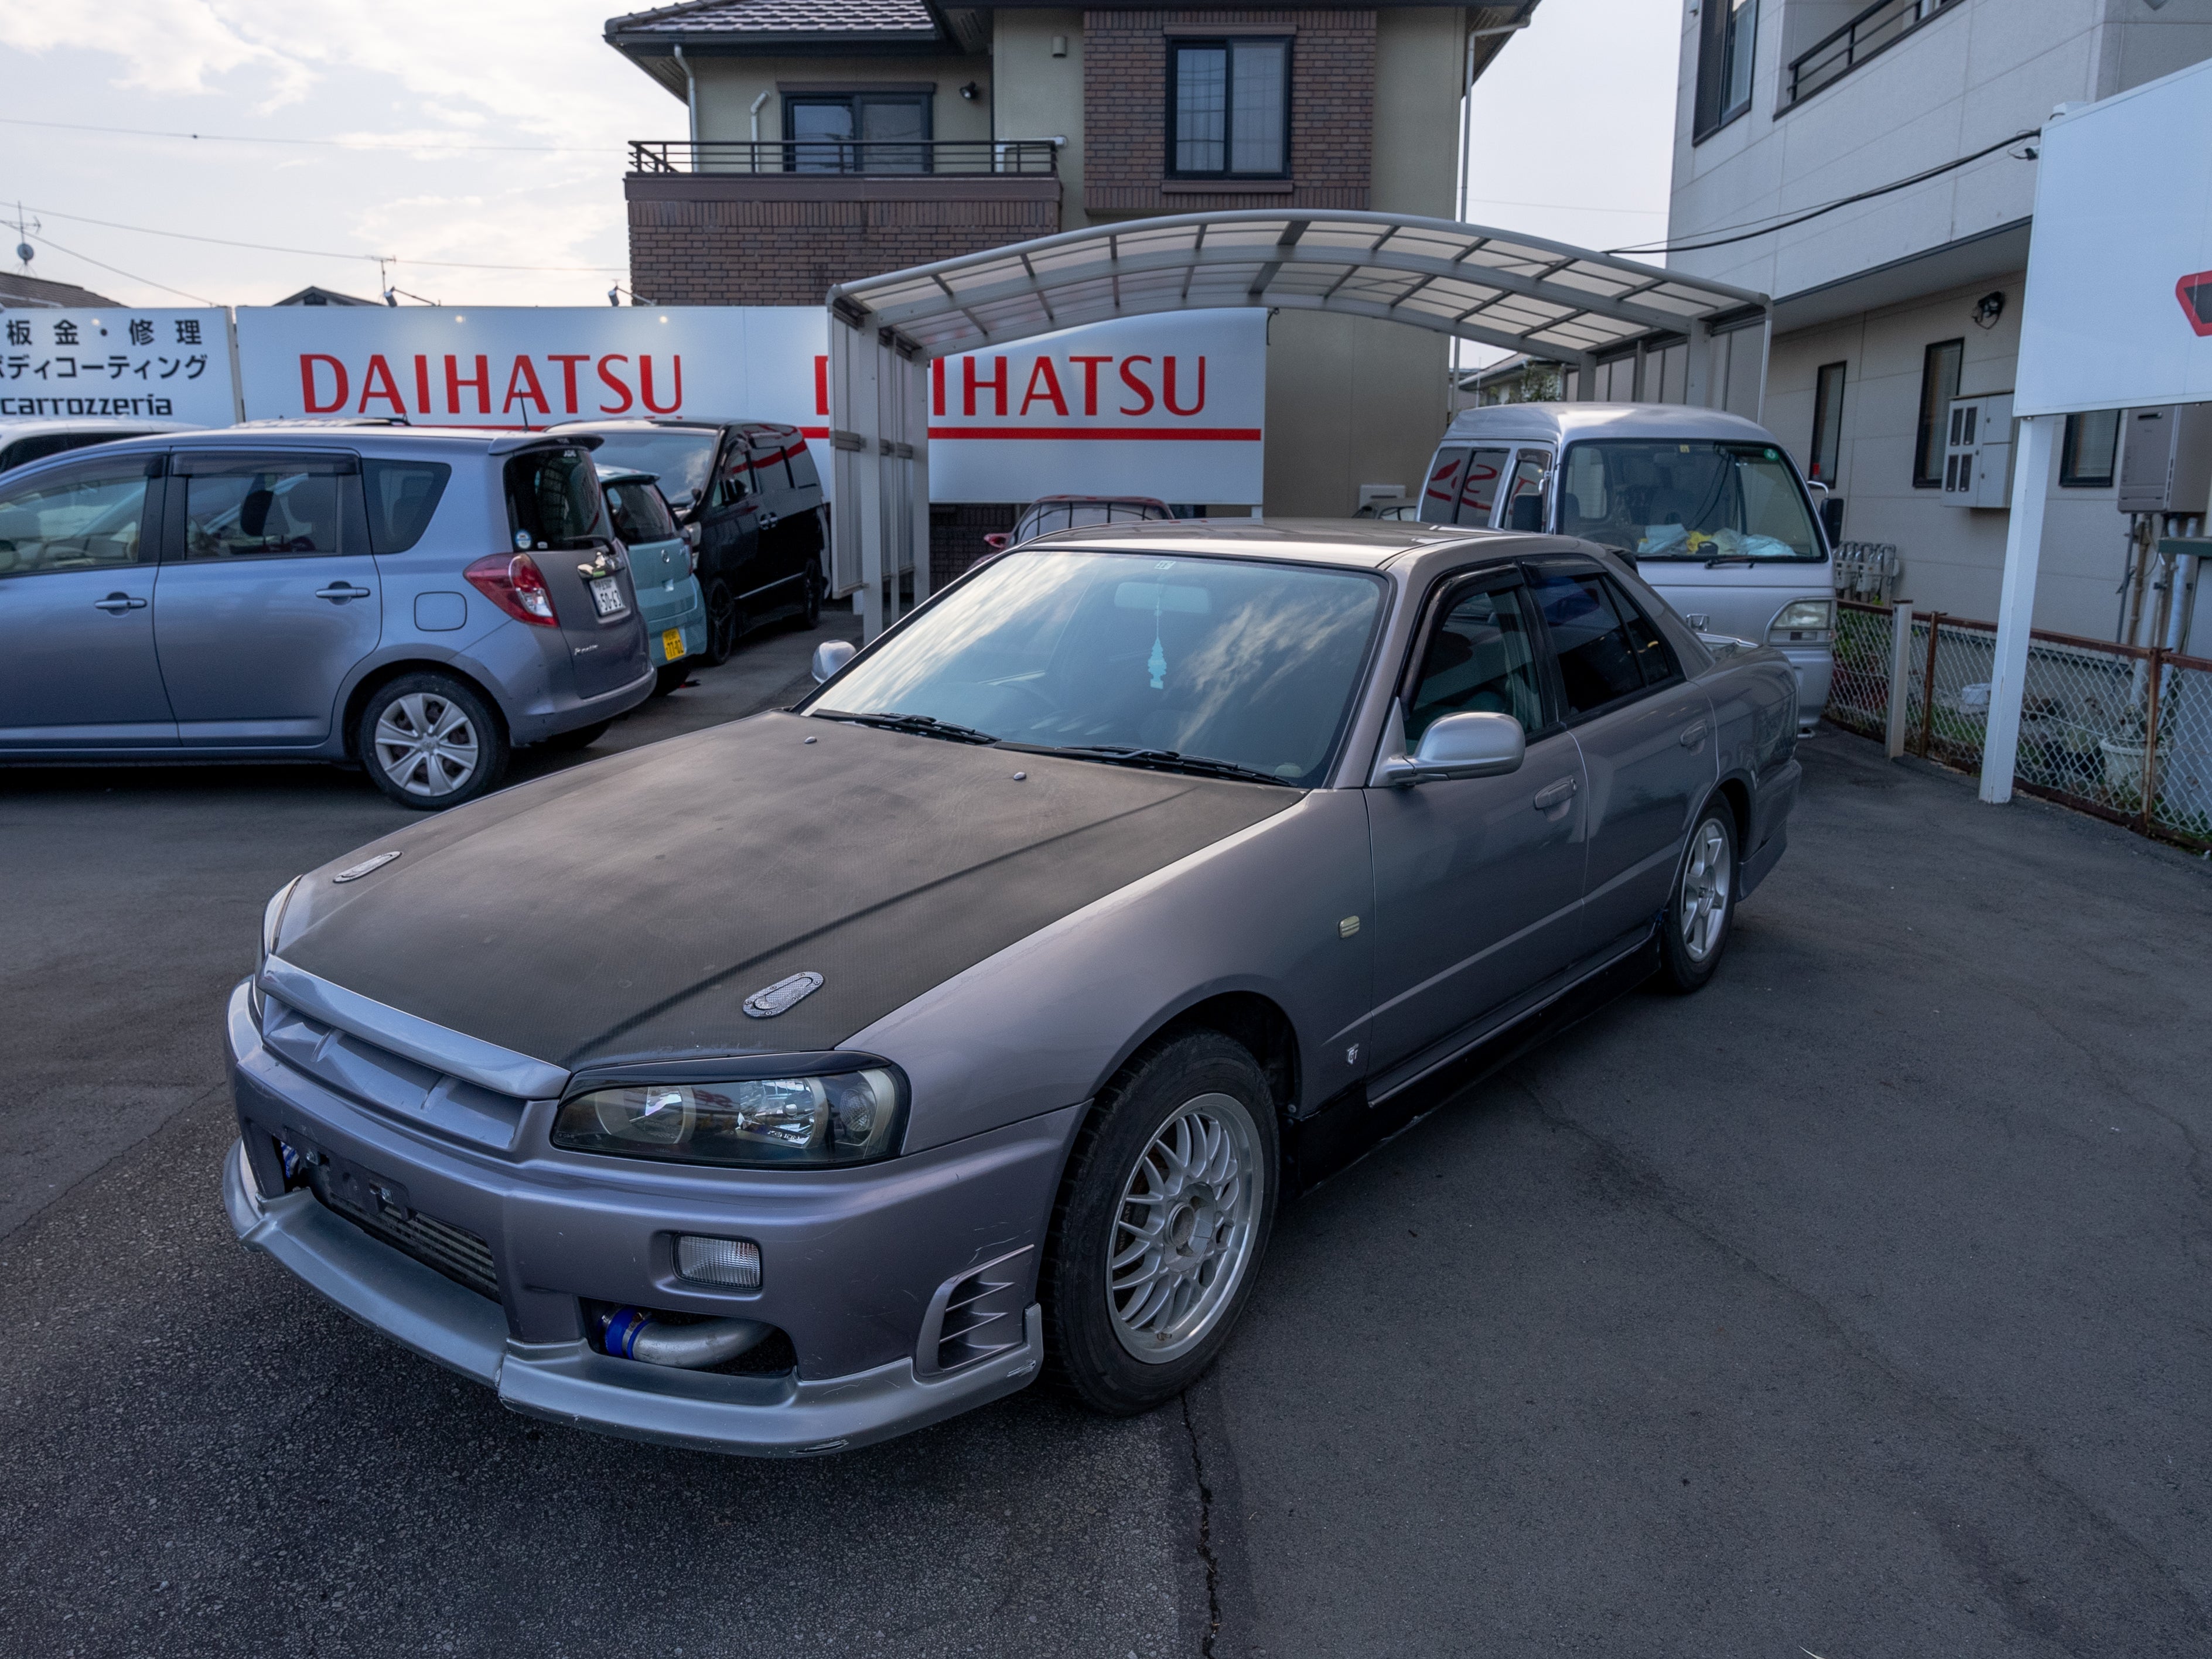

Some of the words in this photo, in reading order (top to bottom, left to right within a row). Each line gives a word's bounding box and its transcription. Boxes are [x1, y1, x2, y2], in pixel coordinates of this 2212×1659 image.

[0, 354, 207, 380] ディコーティング
[301, 354, 682, 414] DAIHATSU
[1, 394, 173, 415] carrozzeria
